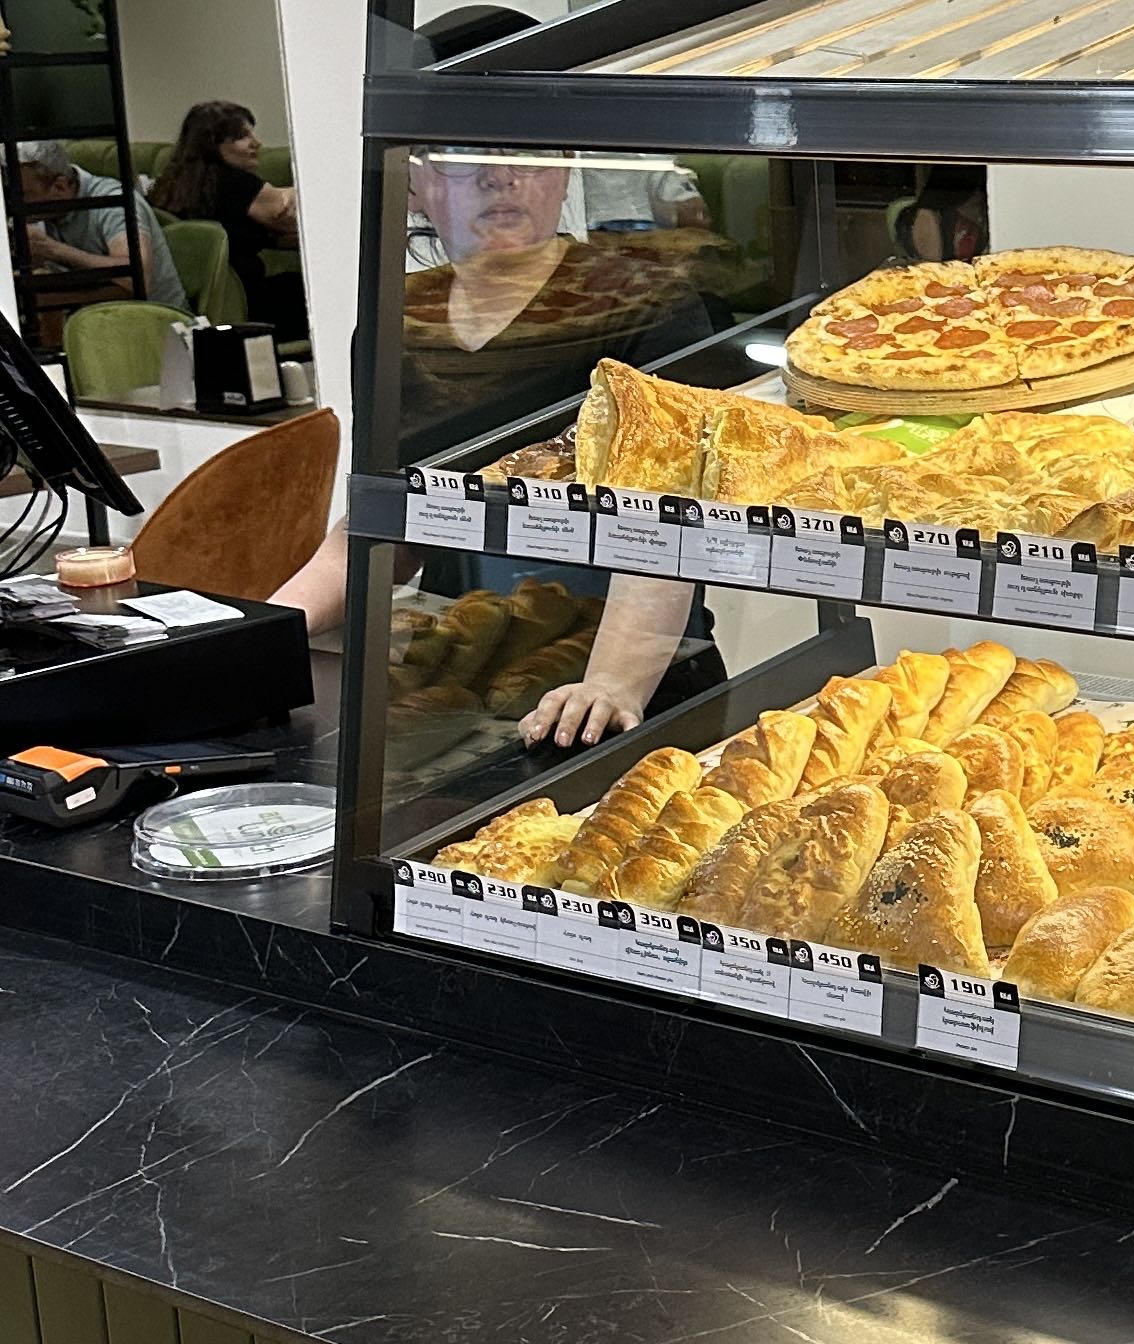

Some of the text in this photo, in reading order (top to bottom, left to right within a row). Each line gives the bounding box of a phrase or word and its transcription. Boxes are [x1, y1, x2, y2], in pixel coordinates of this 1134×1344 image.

[430, 475, 458, 490] 310
[532, 486, 562, 500] 310
[621, 497, 653, 511] 210
[708, 509, 742, 522] 450
[800, 517, 834, 532] 370
[914, 530, 950, 545] 270
[1028, 544, 1064, 560] 210
[417, 869, 446, 884] 290
[487, 883, 517, 899] 230
[562, 898, 593, 914] 230
[640, 912, 672, 930] 350
[729, 934, 761, 951] 350
[818, 952, 853, 969] 450
[950, 978, 986, 997] 190
